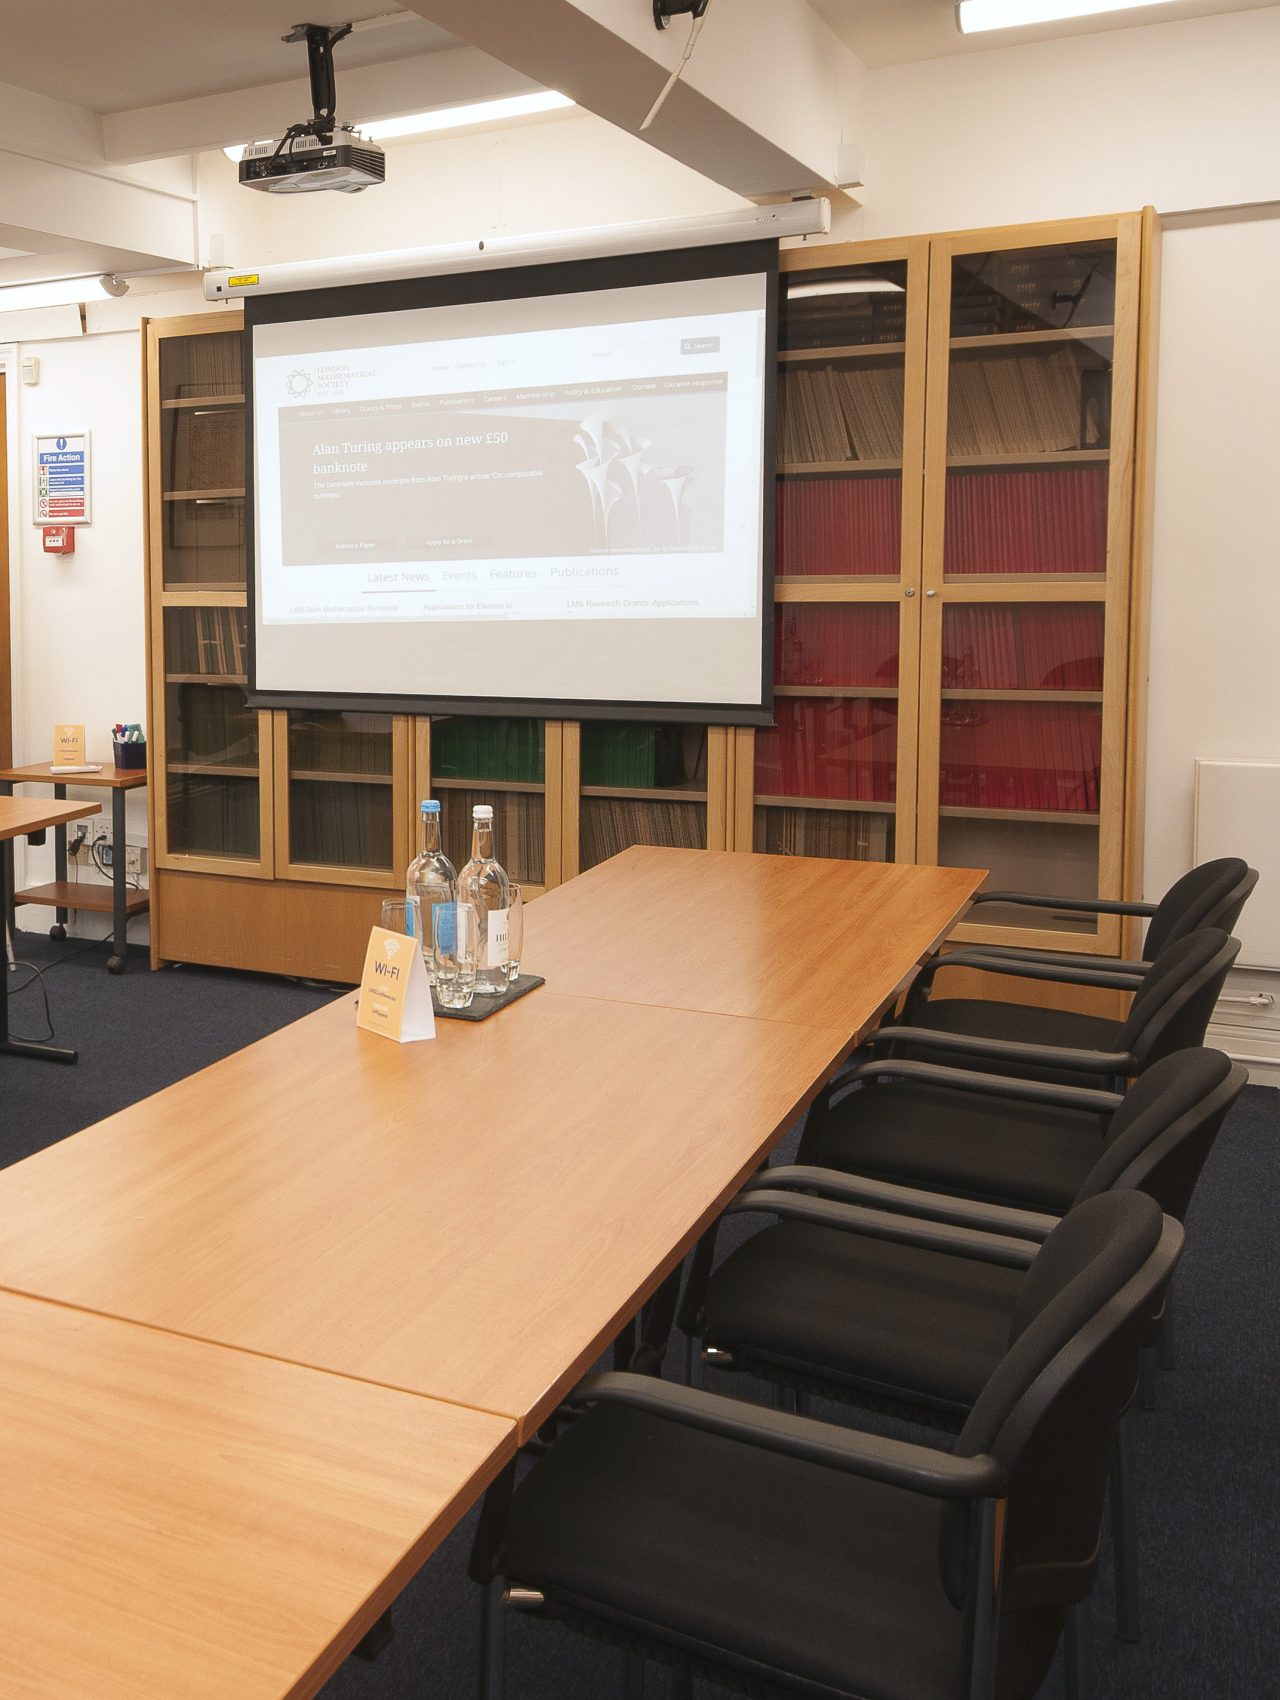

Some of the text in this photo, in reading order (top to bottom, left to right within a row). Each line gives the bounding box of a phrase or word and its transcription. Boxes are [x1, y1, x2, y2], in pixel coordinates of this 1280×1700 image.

[317, 363, 351, 374] LONDON
[317, 380, 351, 390] SOCIETY
[632, 382, 657, 391] Donate
[664, 377, 724, 389] Ukraine response
[516, 390, 556, 402] Membership
[564, 387, 582, 398] Policy
[591, 384, 623, 394] Education
[439, 396, 475, 408] Publications
[483, 394, 508, 403] Careers
[312, 431, 510, 456] Alan Turing appears on new £50
[43, 453, 81, 463] Fire Action
[312, 461, 369, 475] banknote
[367, 571, 431, 583] Latest News
[442, 569, 478, 581] Events
[489, 567, 537, 579] Features
[550, 565, 620, 578] Publications
[375, 960, 401, 981] WI-FI
